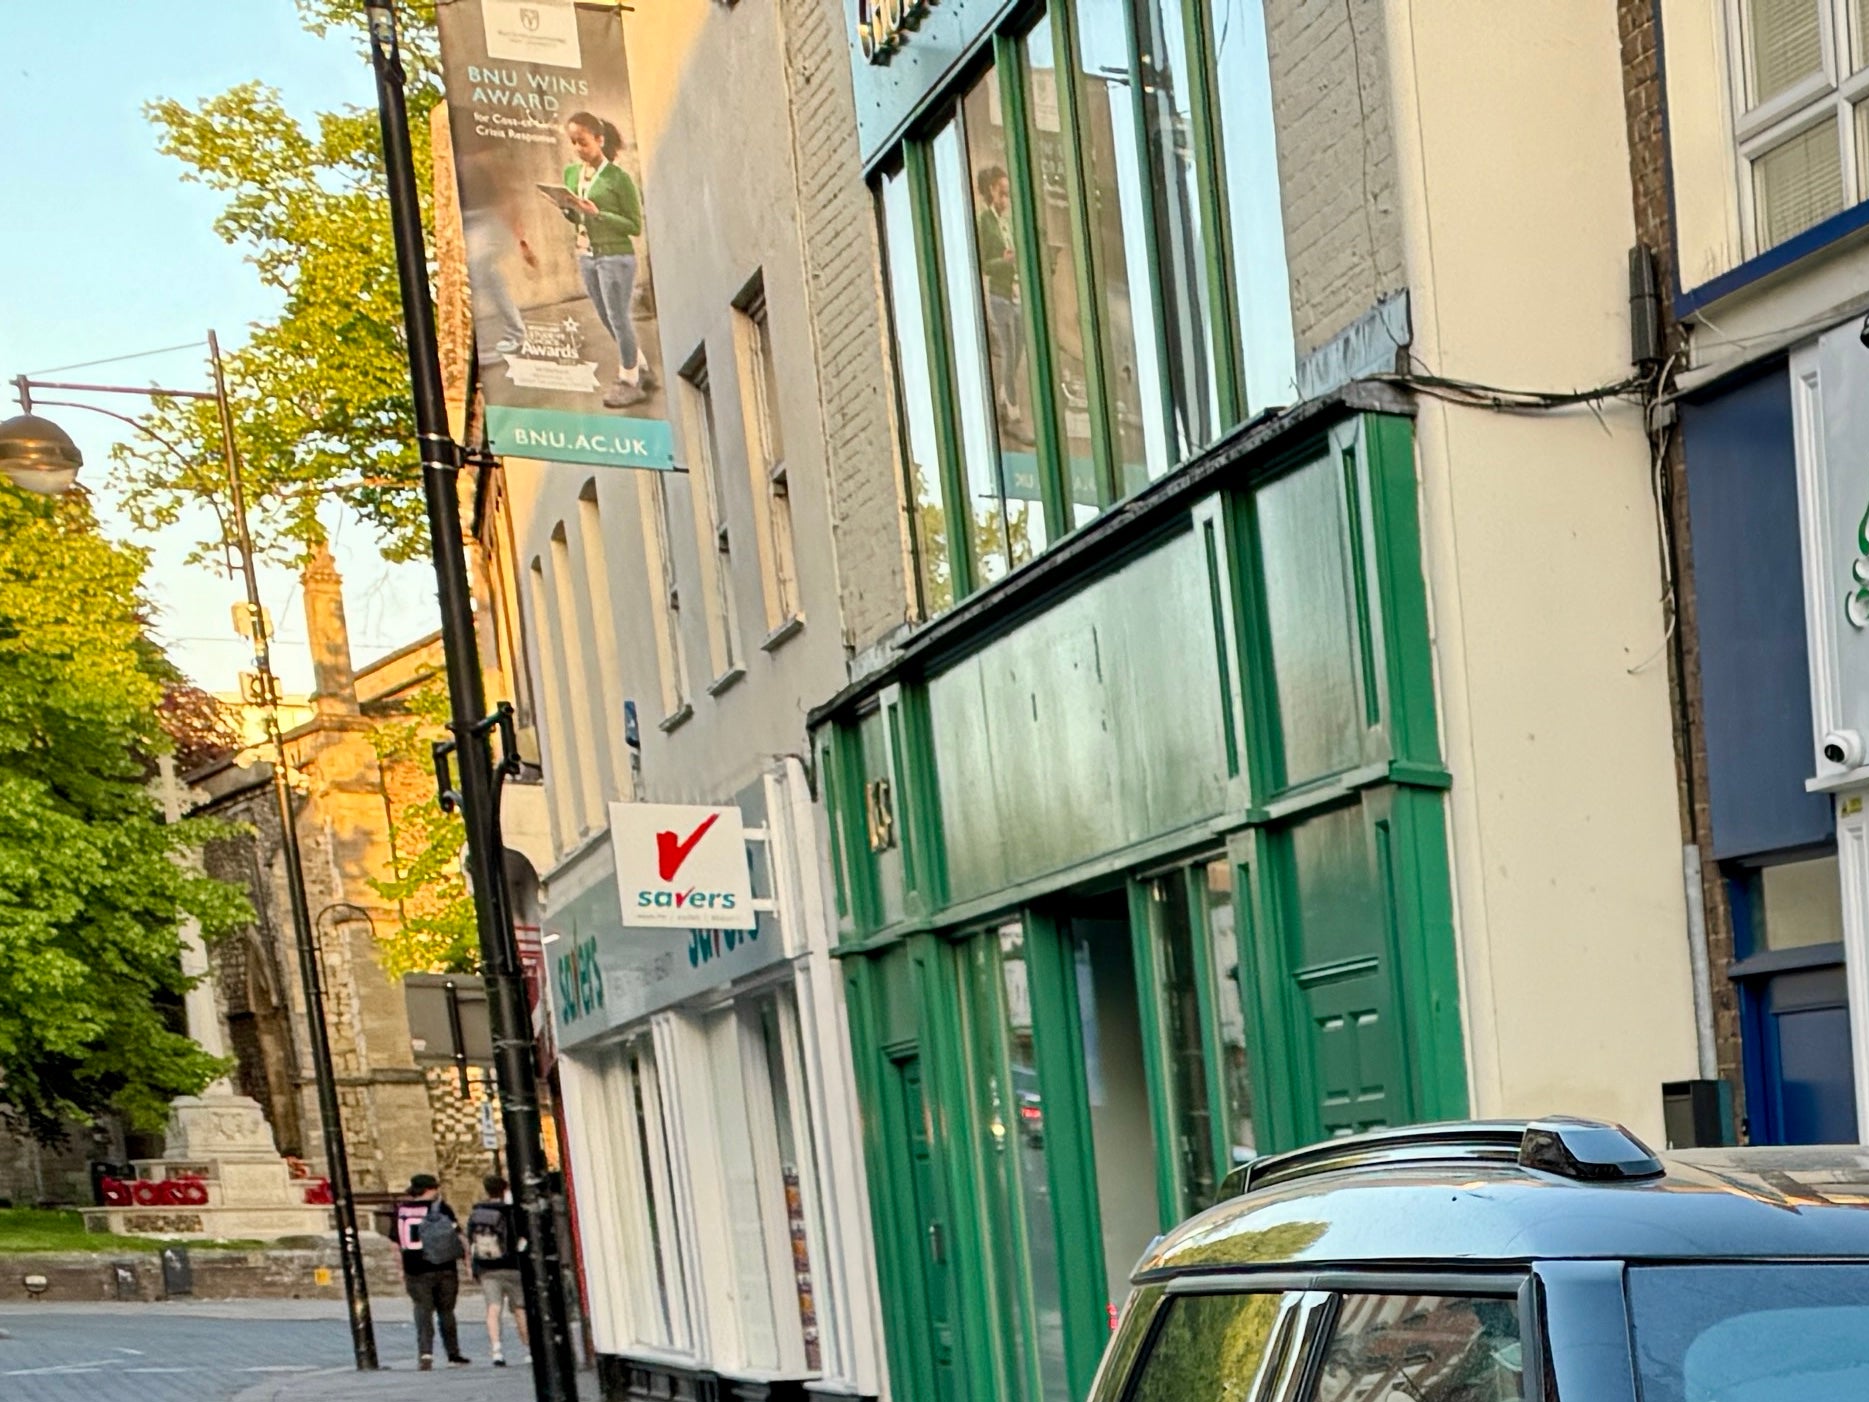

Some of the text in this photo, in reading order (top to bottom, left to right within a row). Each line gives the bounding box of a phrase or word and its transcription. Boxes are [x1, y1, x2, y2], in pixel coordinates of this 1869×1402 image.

[467, 66, 589, 96] BNU WINS
[472, 88, 559, 112] AWARD
[514, 428, 648, 456] BNU.AC.UK
[637, 886, 735, 909] savers
